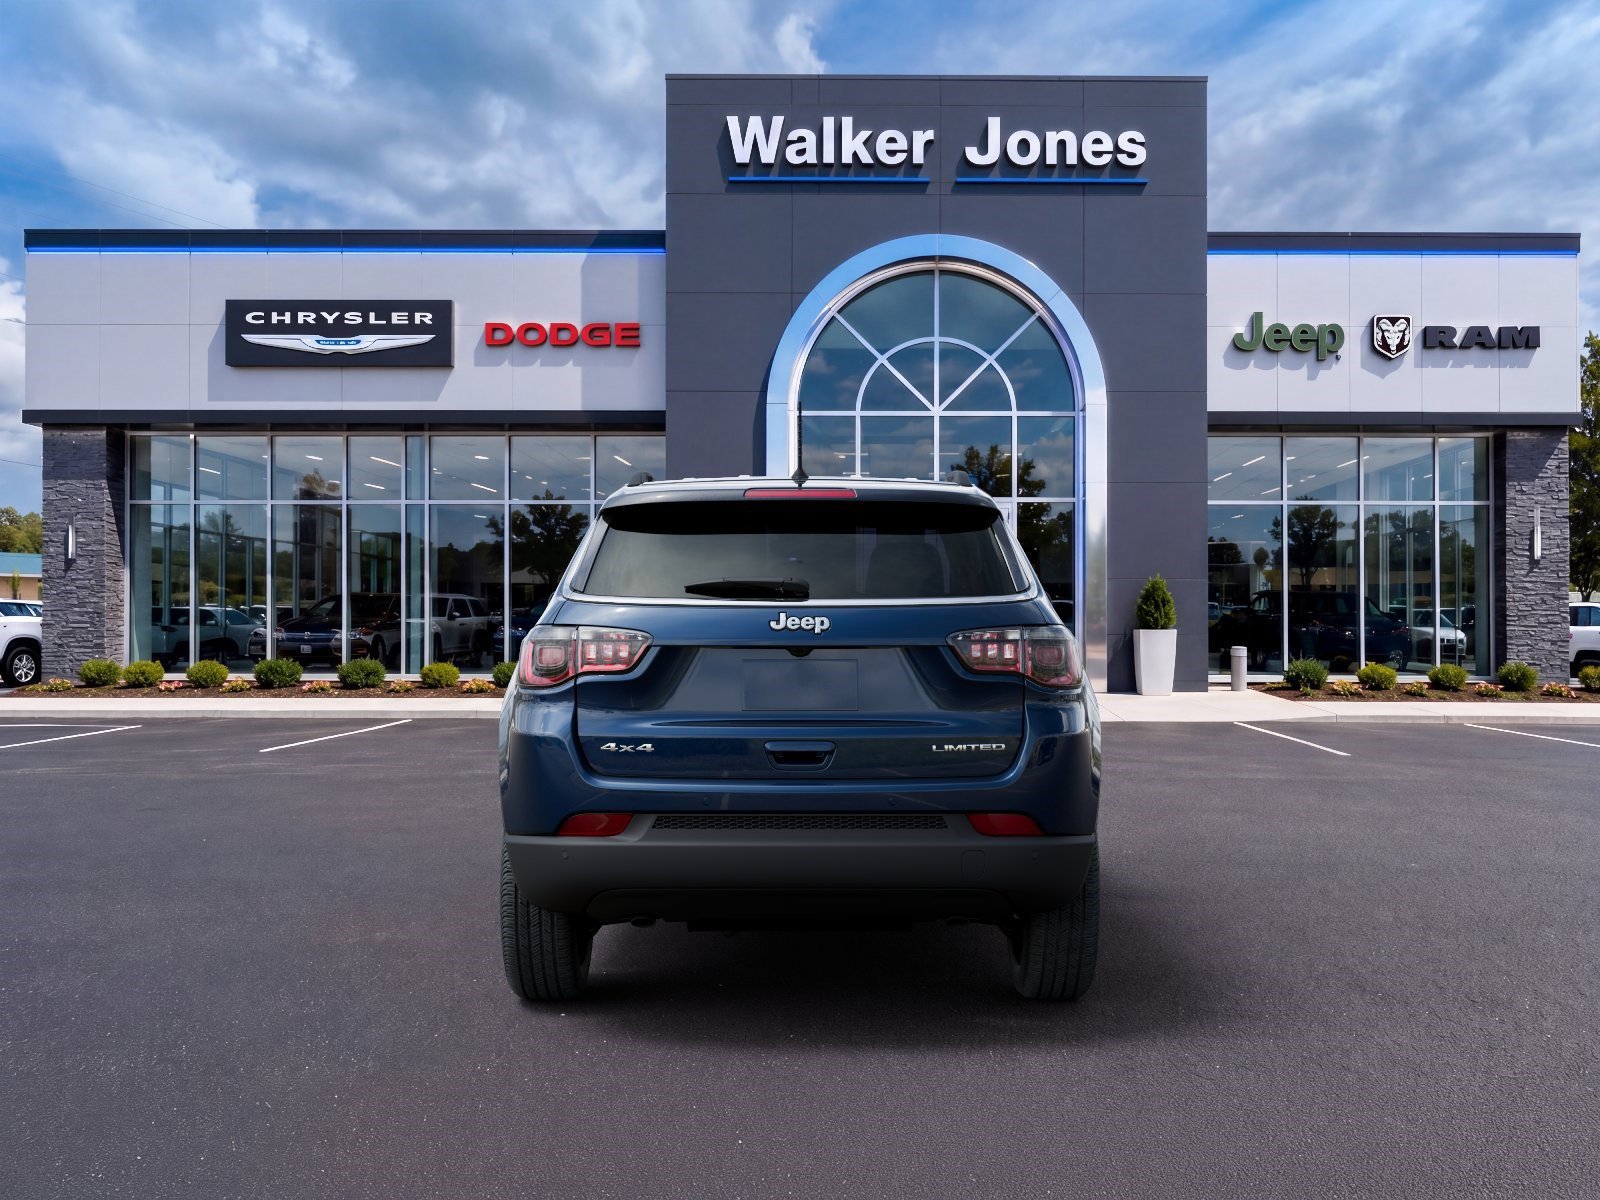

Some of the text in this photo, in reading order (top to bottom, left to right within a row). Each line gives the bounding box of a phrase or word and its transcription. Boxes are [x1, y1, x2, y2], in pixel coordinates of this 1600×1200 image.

[726, 115, 1149, 166] Walker Jones
[245, 311, 433, 325] CHRYSLER
[485, 321, 641, 348] DODGE
[1233, 312, 1345, 361] Jeep
[1423, 325, 1541, 348] RAM
[769, 612, 832, 634] Jeep
[599, 742, 655, 753] 4x4
[932, 744, 1006, 752] LIMITED
